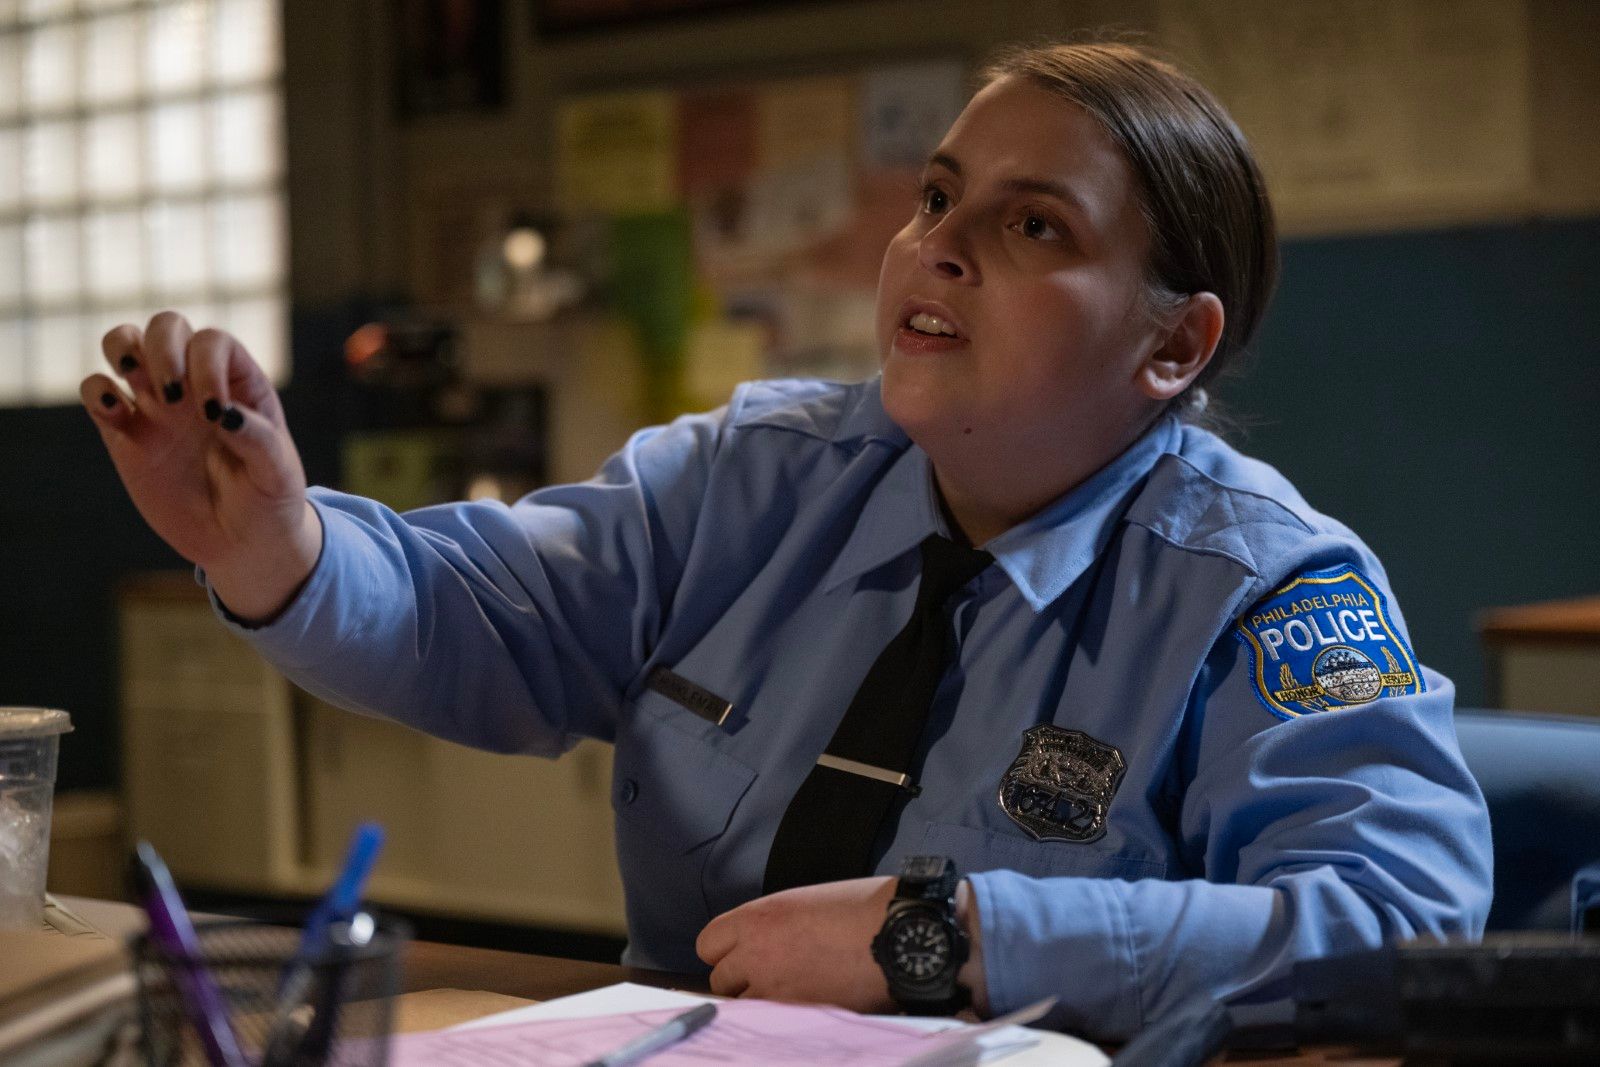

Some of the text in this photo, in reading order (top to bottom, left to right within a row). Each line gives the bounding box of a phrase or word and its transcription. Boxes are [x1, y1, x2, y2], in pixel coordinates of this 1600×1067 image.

[1252, 593, 1369, 628] PHILADELPHIA
[1259, 609, 1387, 661] POLICE
[1279, 685, 1320, 701] HONOR
